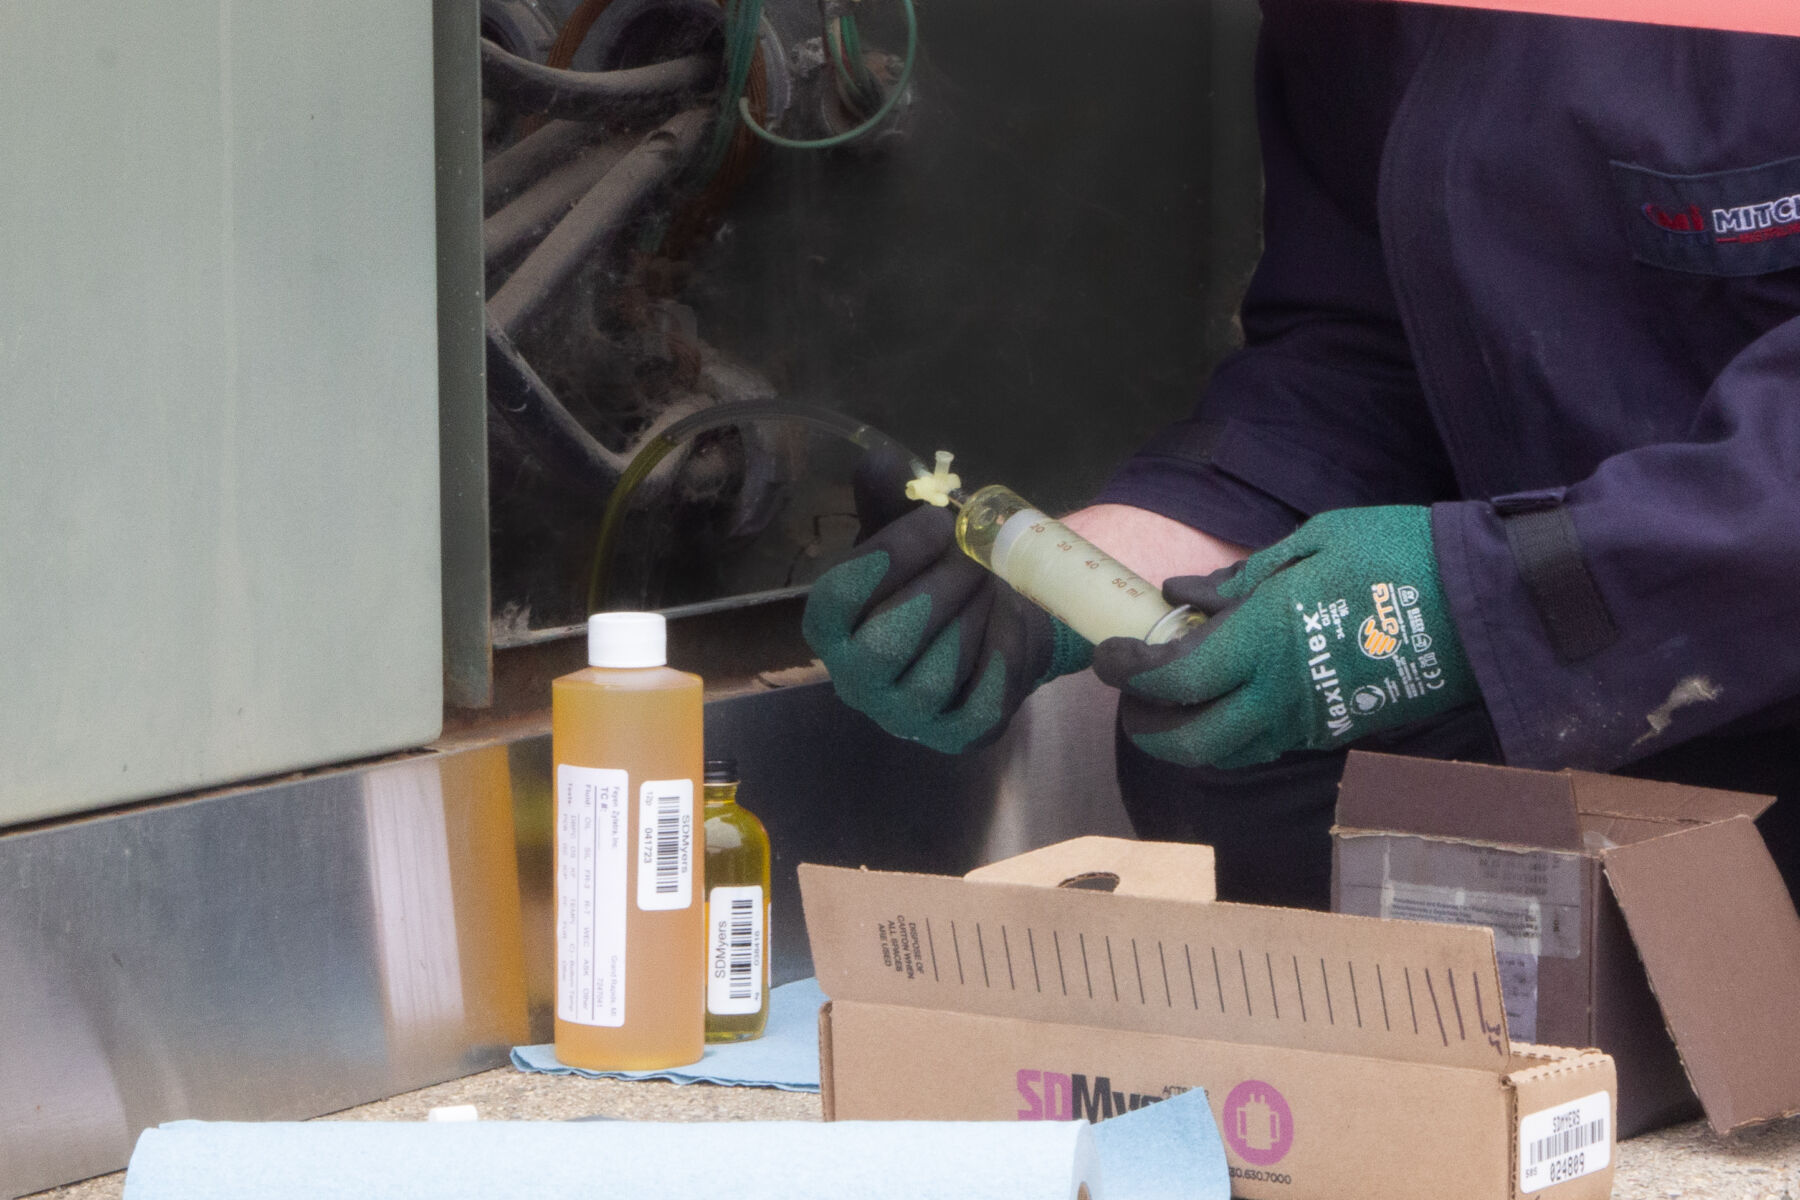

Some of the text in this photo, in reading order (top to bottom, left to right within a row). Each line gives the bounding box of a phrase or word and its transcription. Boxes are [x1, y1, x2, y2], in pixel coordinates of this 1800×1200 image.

[1030, 523, 1045, 534] 20
[1057, 540, 1073, 552] 30
[1084, 559, 1100, 570] 40
[1111, 577, 1144, 599] 50 ml
[1302, 611, 1353, 737] MaxiFlex
[600, 786, 608, 800] TC
[644, 827, 653, 864] 041723
[680, 815, 690, 874] SDMyers
[715, 920, 728, 979] SDMyers
[1228, 1166, 1292, 1185] 30.630.7000
[1550, 1152, 1585, 1182] 024809
